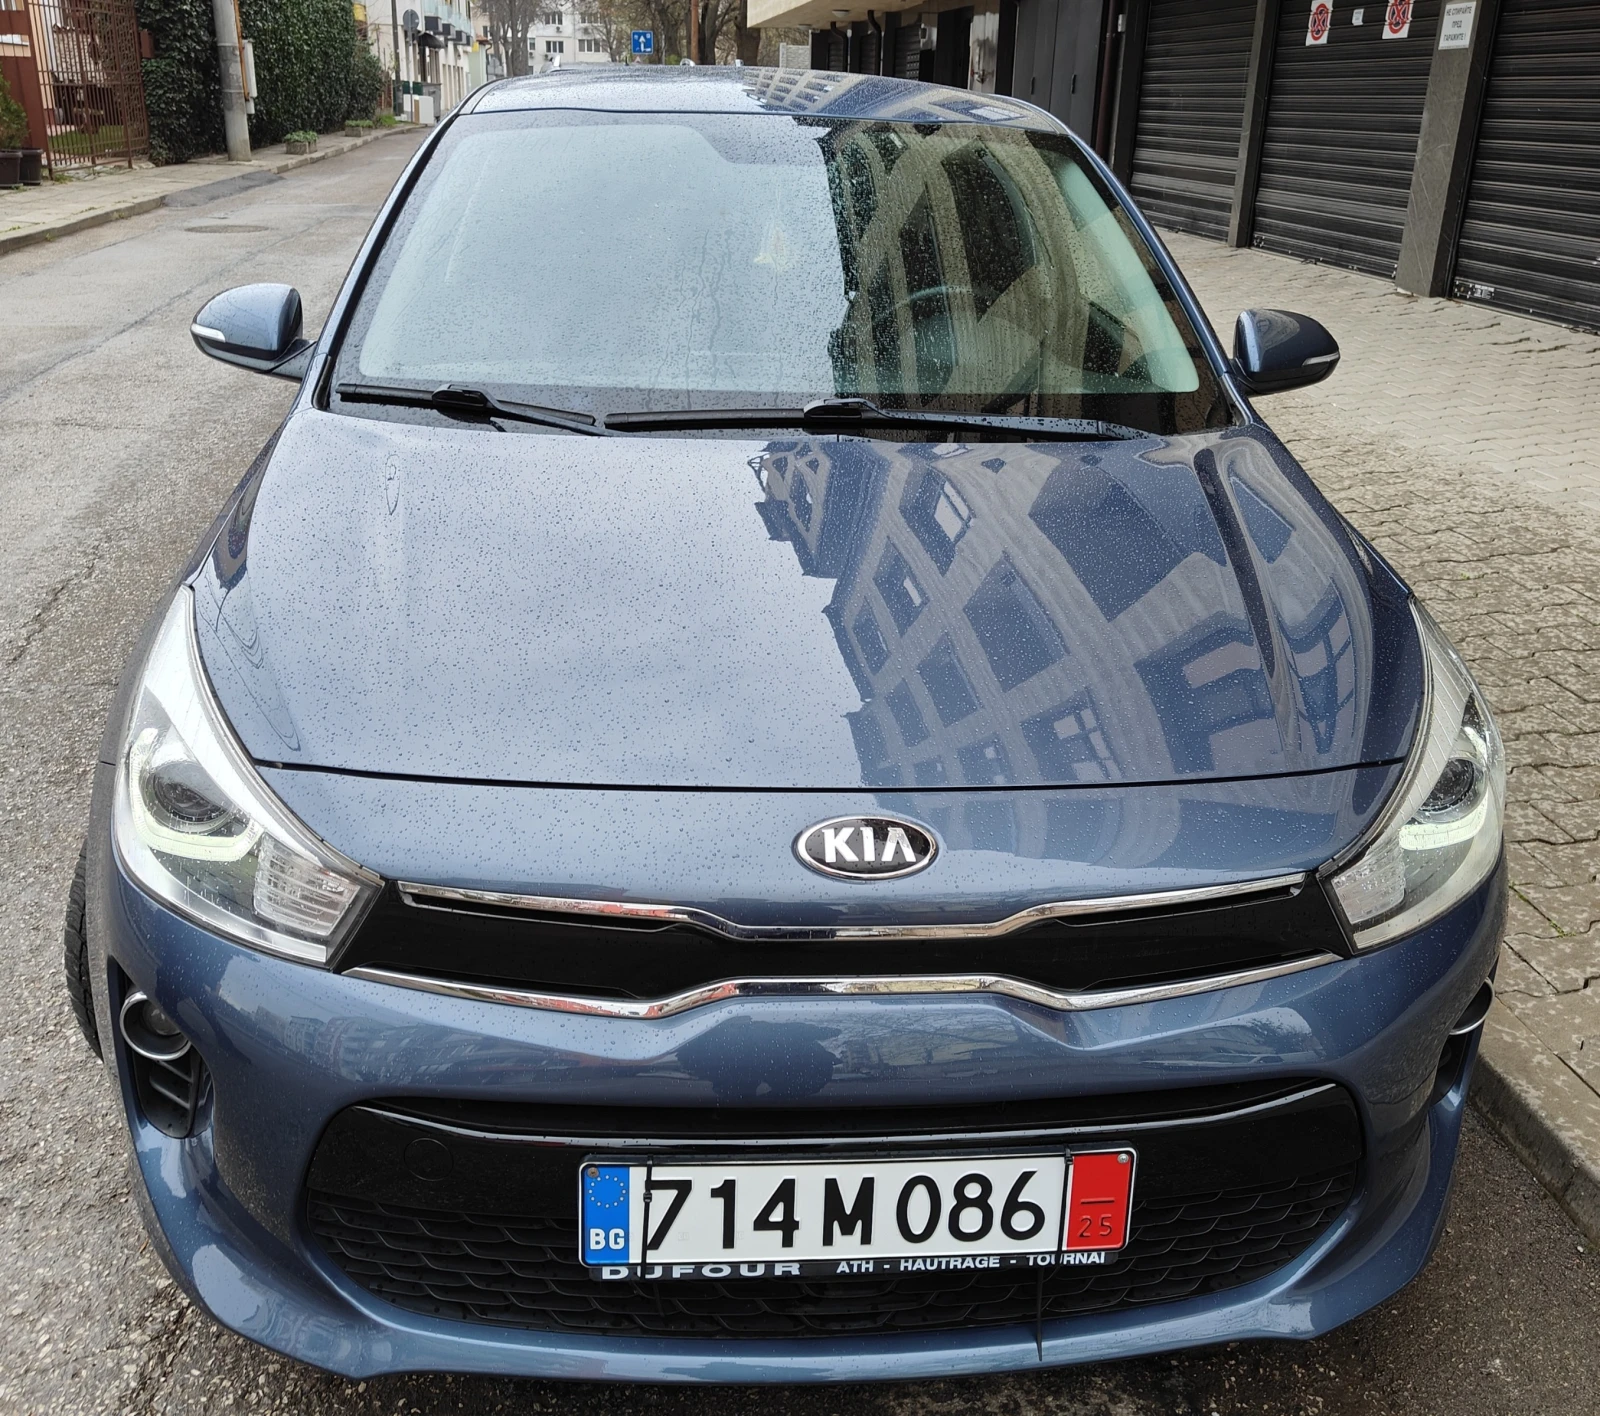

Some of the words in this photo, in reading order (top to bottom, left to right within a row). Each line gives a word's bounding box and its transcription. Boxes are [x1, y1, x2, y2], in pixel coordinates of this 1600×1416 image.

[1452, 20, 1462, 28] ПРЕД
[821, 827, 917, 863] KIA
[645, 1177, 800, 1251] 714
[822, 1177, 875, 1247] M
[896, 1170, 1045, 1244] 086
[1078, 1213, 1113, 1238] 25
[589, 1228, 625, 1250] BG
[601, 1262, 800, 1280] DUFOUR
[836, 1260, 874, 1274] ATH
[900, 1255, 1000, 1271] HAUTRAGE
